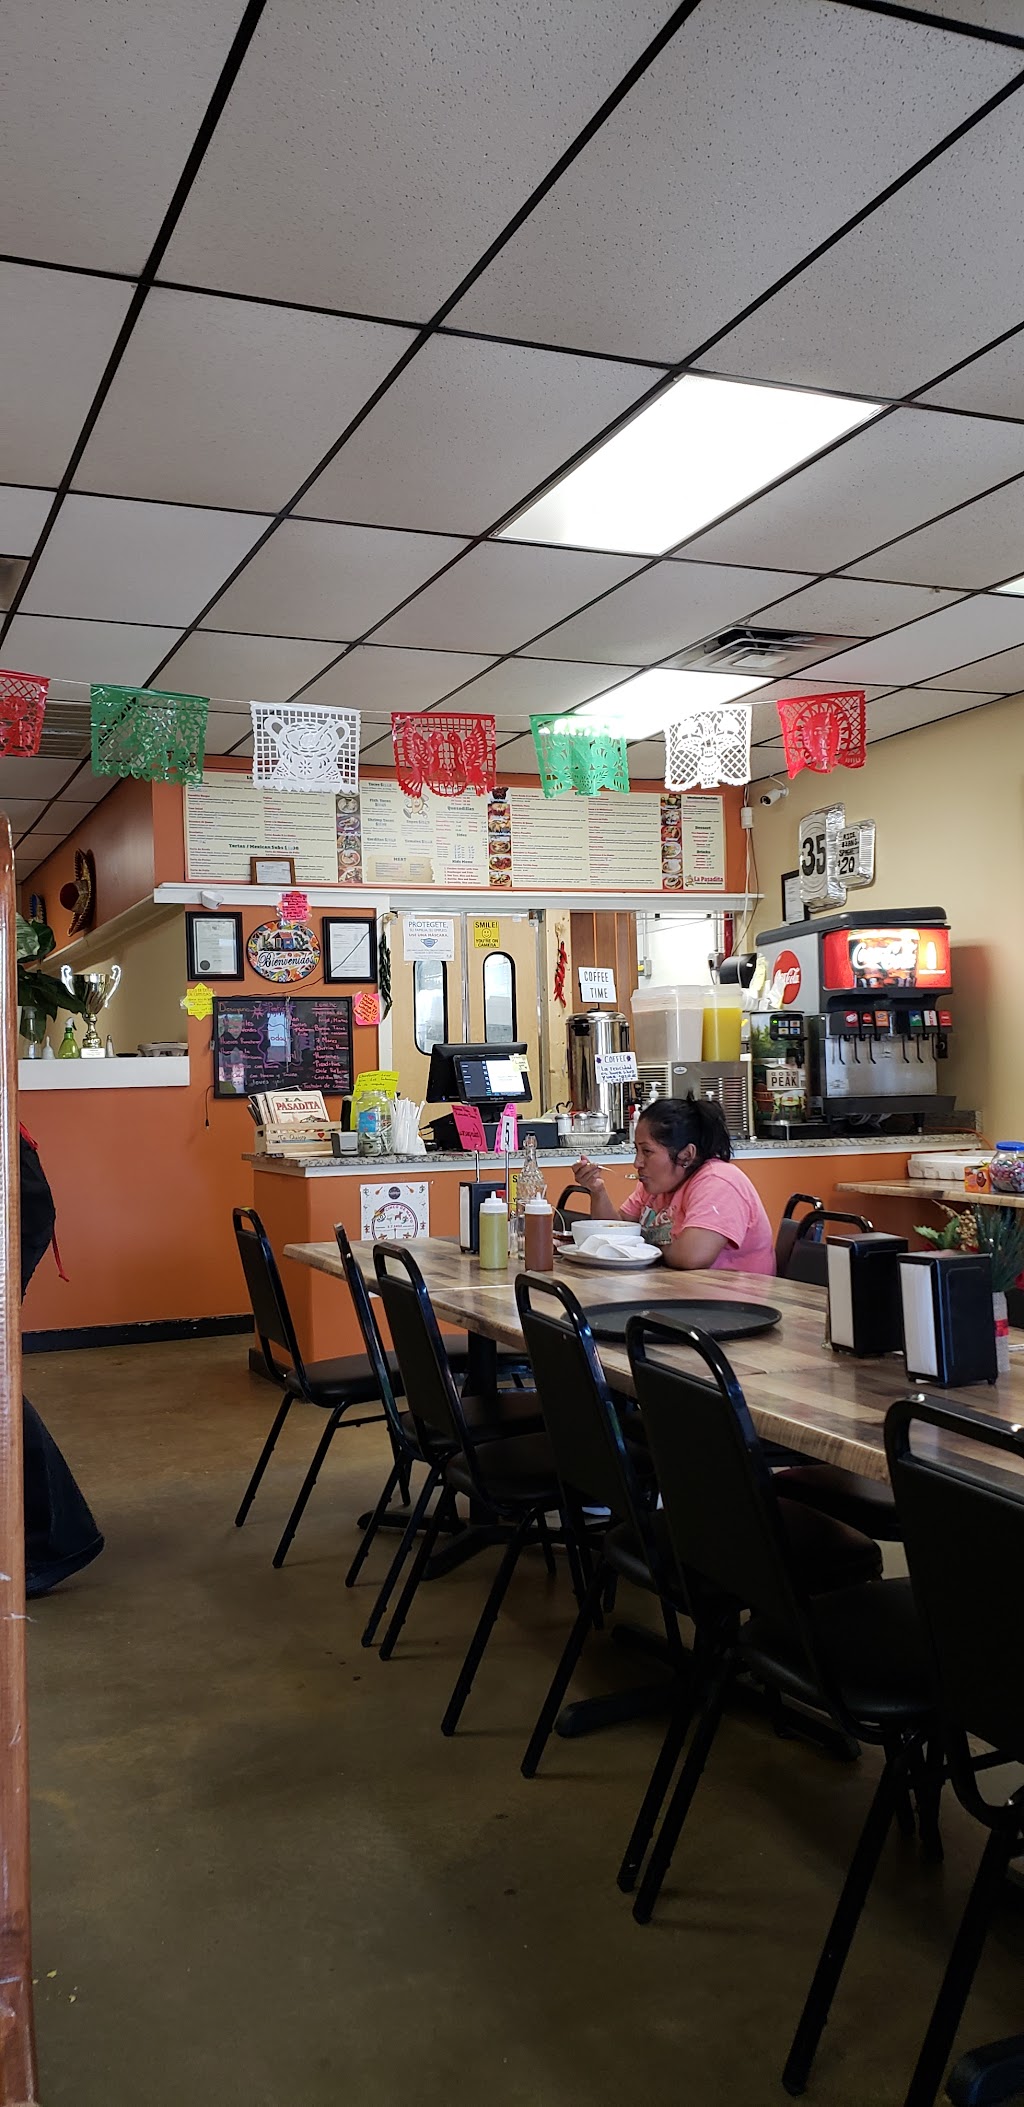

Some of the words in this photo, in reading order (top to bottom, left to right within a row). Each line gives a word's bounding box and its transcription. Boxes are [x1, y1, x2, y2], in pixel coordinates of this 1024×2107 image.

[474, 921, 498, 929] SMILE!
[257, 950, 314, 968] Bienvenidos
[583, 971, 609, 983] COFFEE
[589, 987, 609, 999] TIME
[604, 1055, 626, 1063] COFFEE
[771, 1076, 798, 1087] PEAK
[275, 1101, 321, 1111] PASADITA
